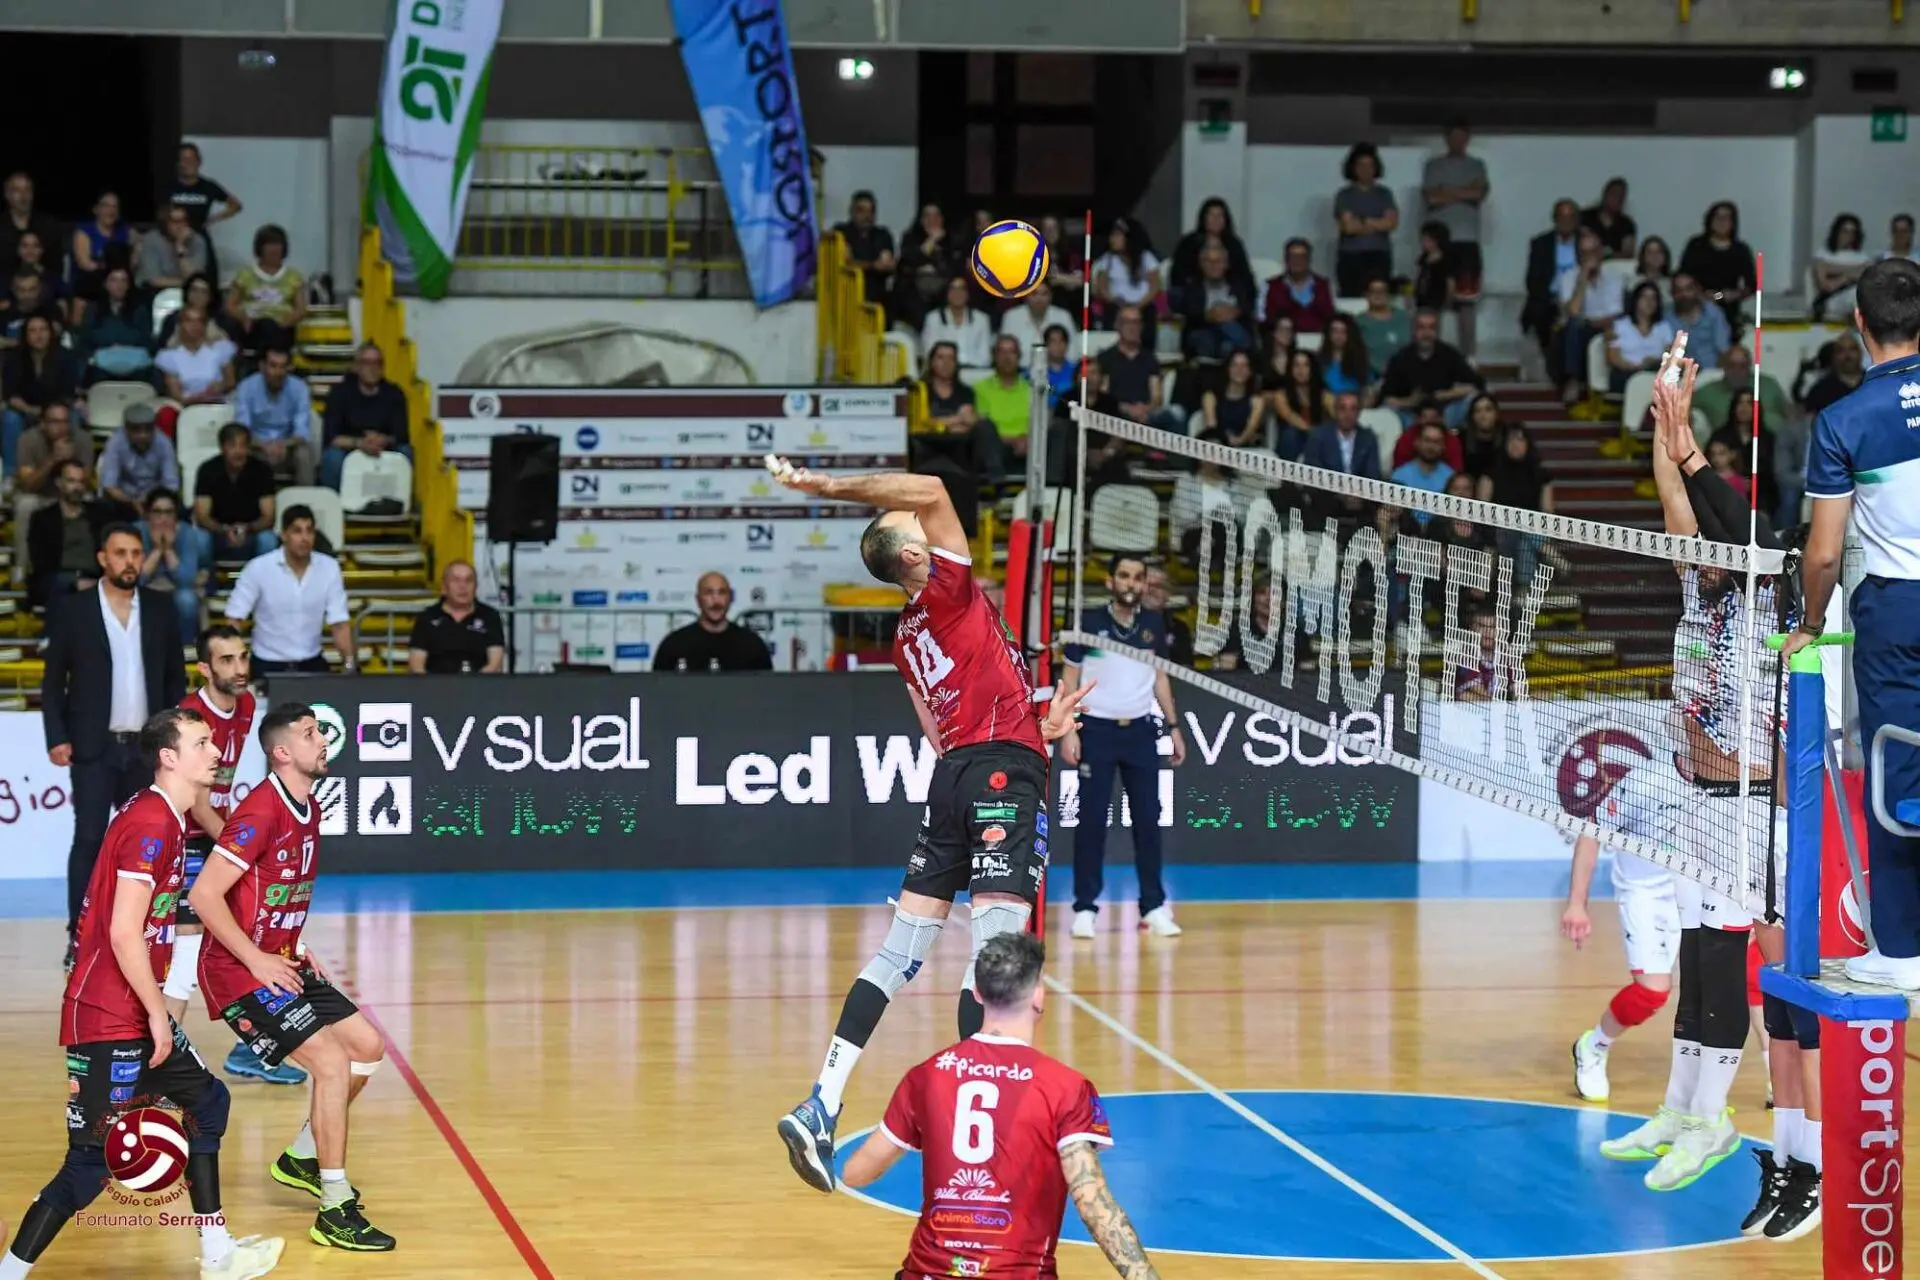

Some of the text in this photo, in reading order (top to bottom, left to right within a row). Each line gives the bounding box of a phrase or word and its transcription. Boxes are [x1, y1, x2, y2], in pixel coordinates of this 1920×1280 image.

[675, 735, 831, 805] Led
[935, 1051, 1034, 1081] #picardo
[1680, 1046, 1701, 1057] 23
[1718, 1055, 1739, 1065] 23
[952, 1080, 1000, 1165] 6
[1847, 1018, 1901, 1280] portSpe
[934, 1211, 1006, 1227] AnimalStore
